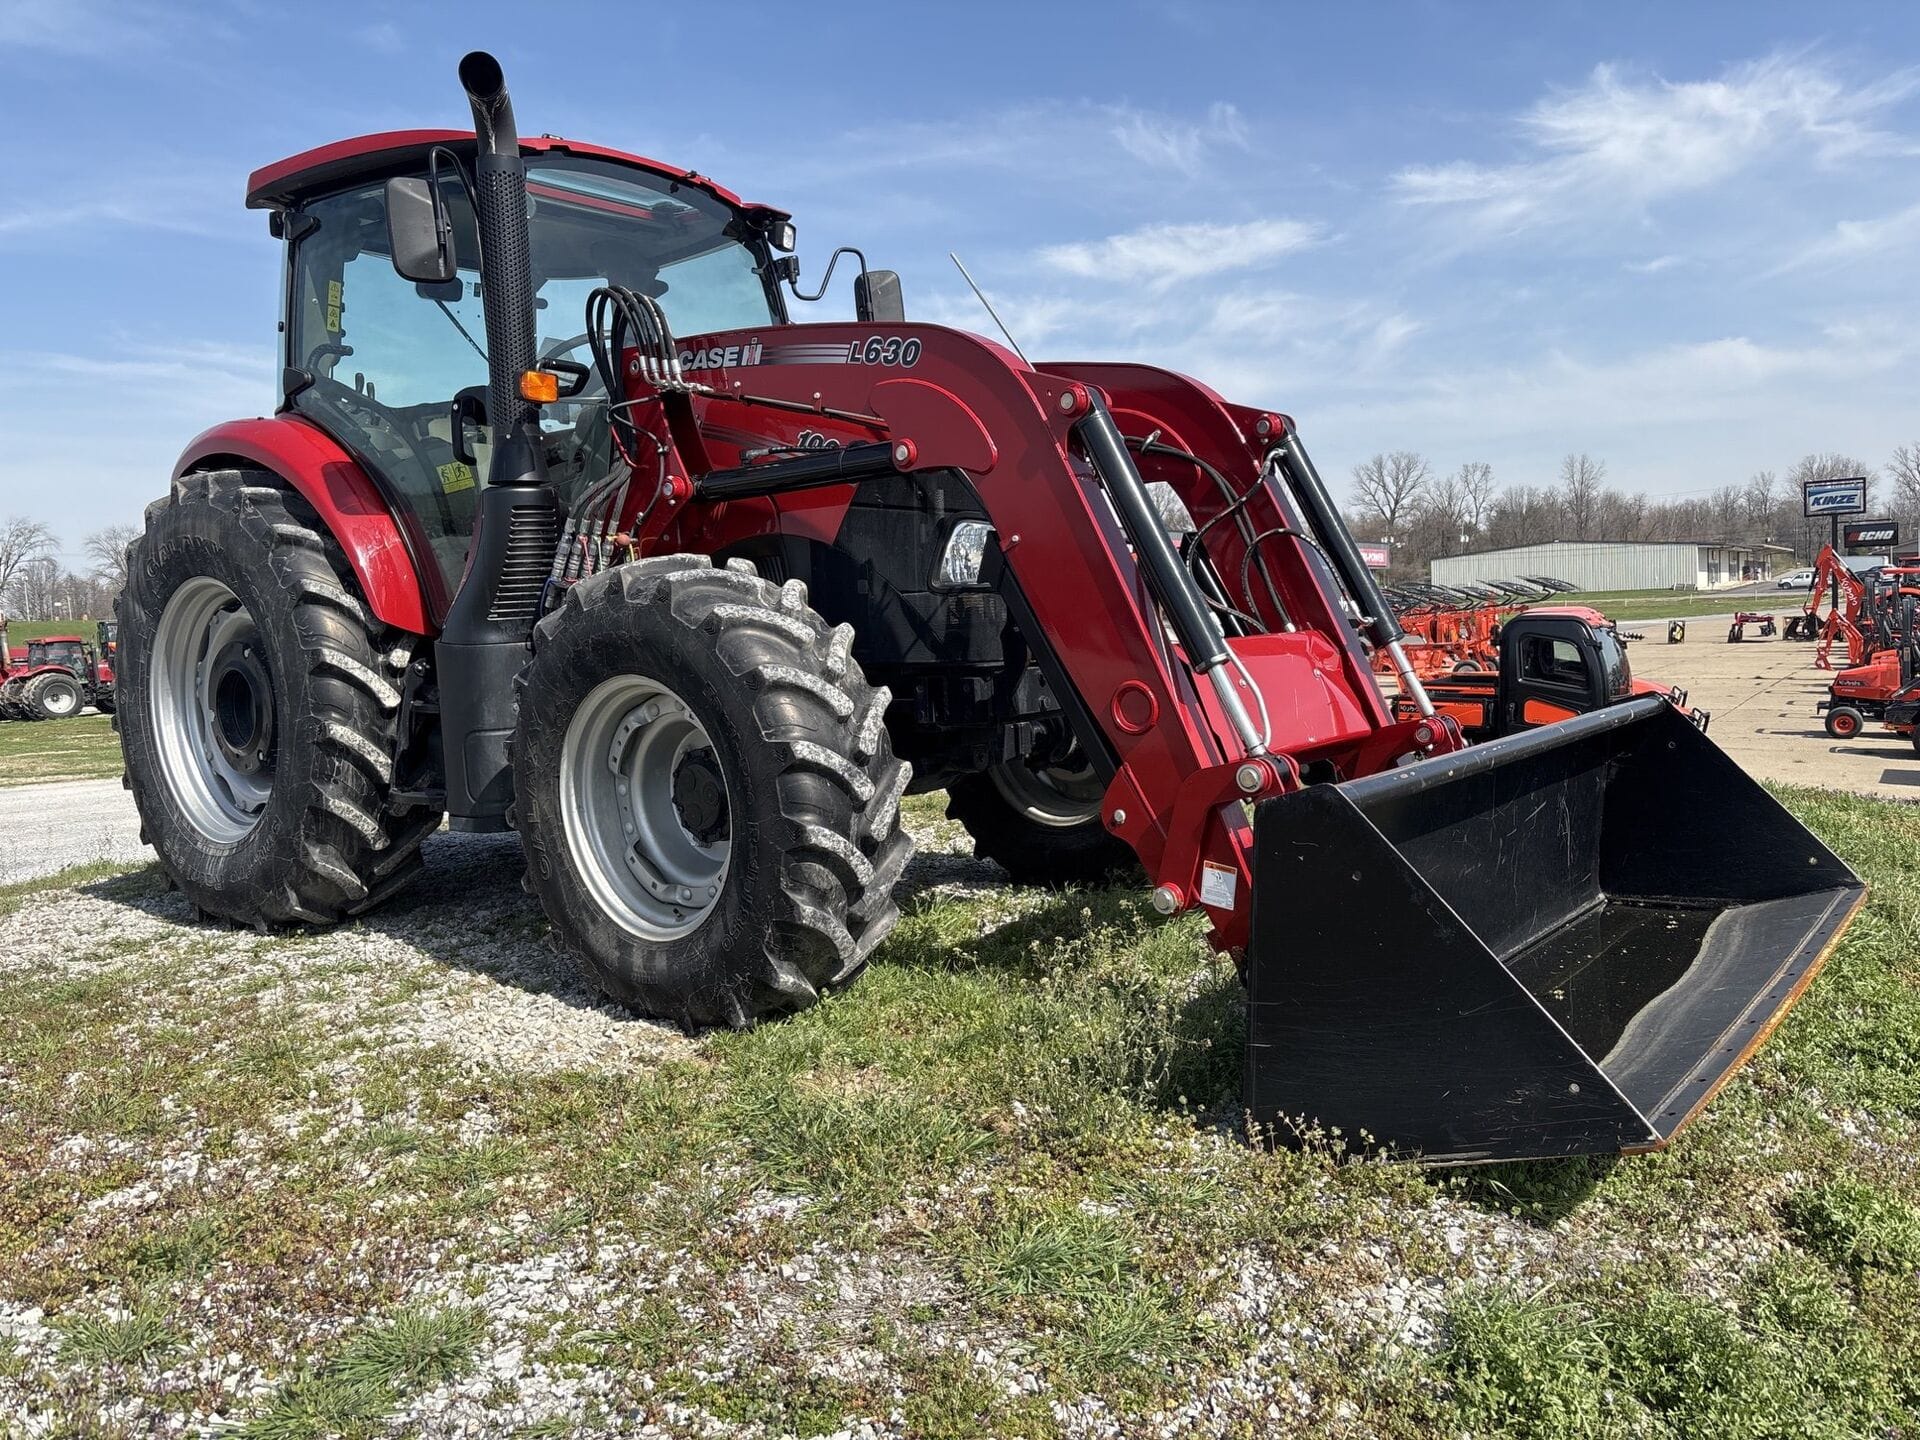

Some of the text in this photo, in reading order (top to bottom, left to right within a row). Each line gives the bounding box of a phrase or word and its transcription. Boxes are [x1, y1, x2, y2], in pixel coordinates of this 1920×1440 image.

[679, 347, 740, 371] CASE
[847, 335, 922, 368] L630
[1811, 494, 1858, 506] KINZE
[1858, 530, 1895, 541] ECHO
[1841, 577, 1858, 606] Kubota
